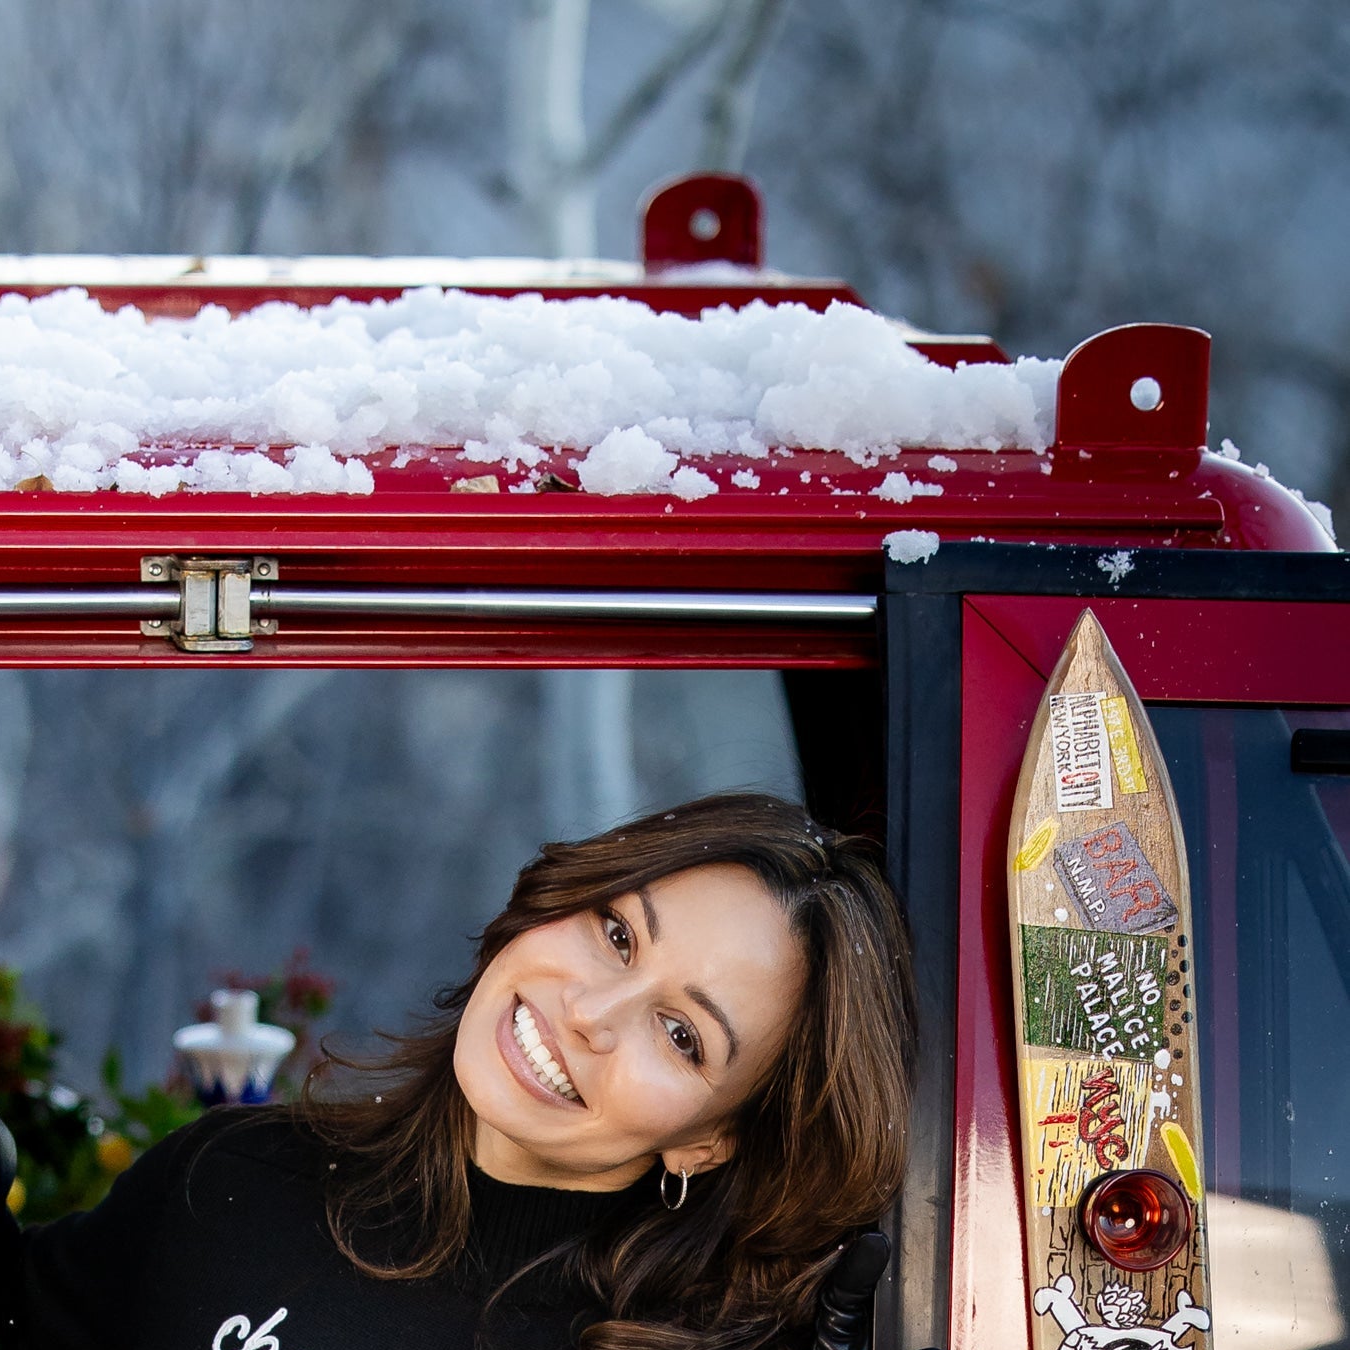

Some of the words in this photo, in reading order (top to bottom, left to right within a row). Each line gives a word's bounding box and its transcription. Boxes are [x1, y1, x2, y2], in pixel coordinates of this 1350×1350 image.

[1067, 857, 1107, 923] N.M.P.
[1083, 827, 1164, 922] BAR
[1070, 962, 1125, 1062] PALACE
[1097, 951, 1150, 1049] MALICE
